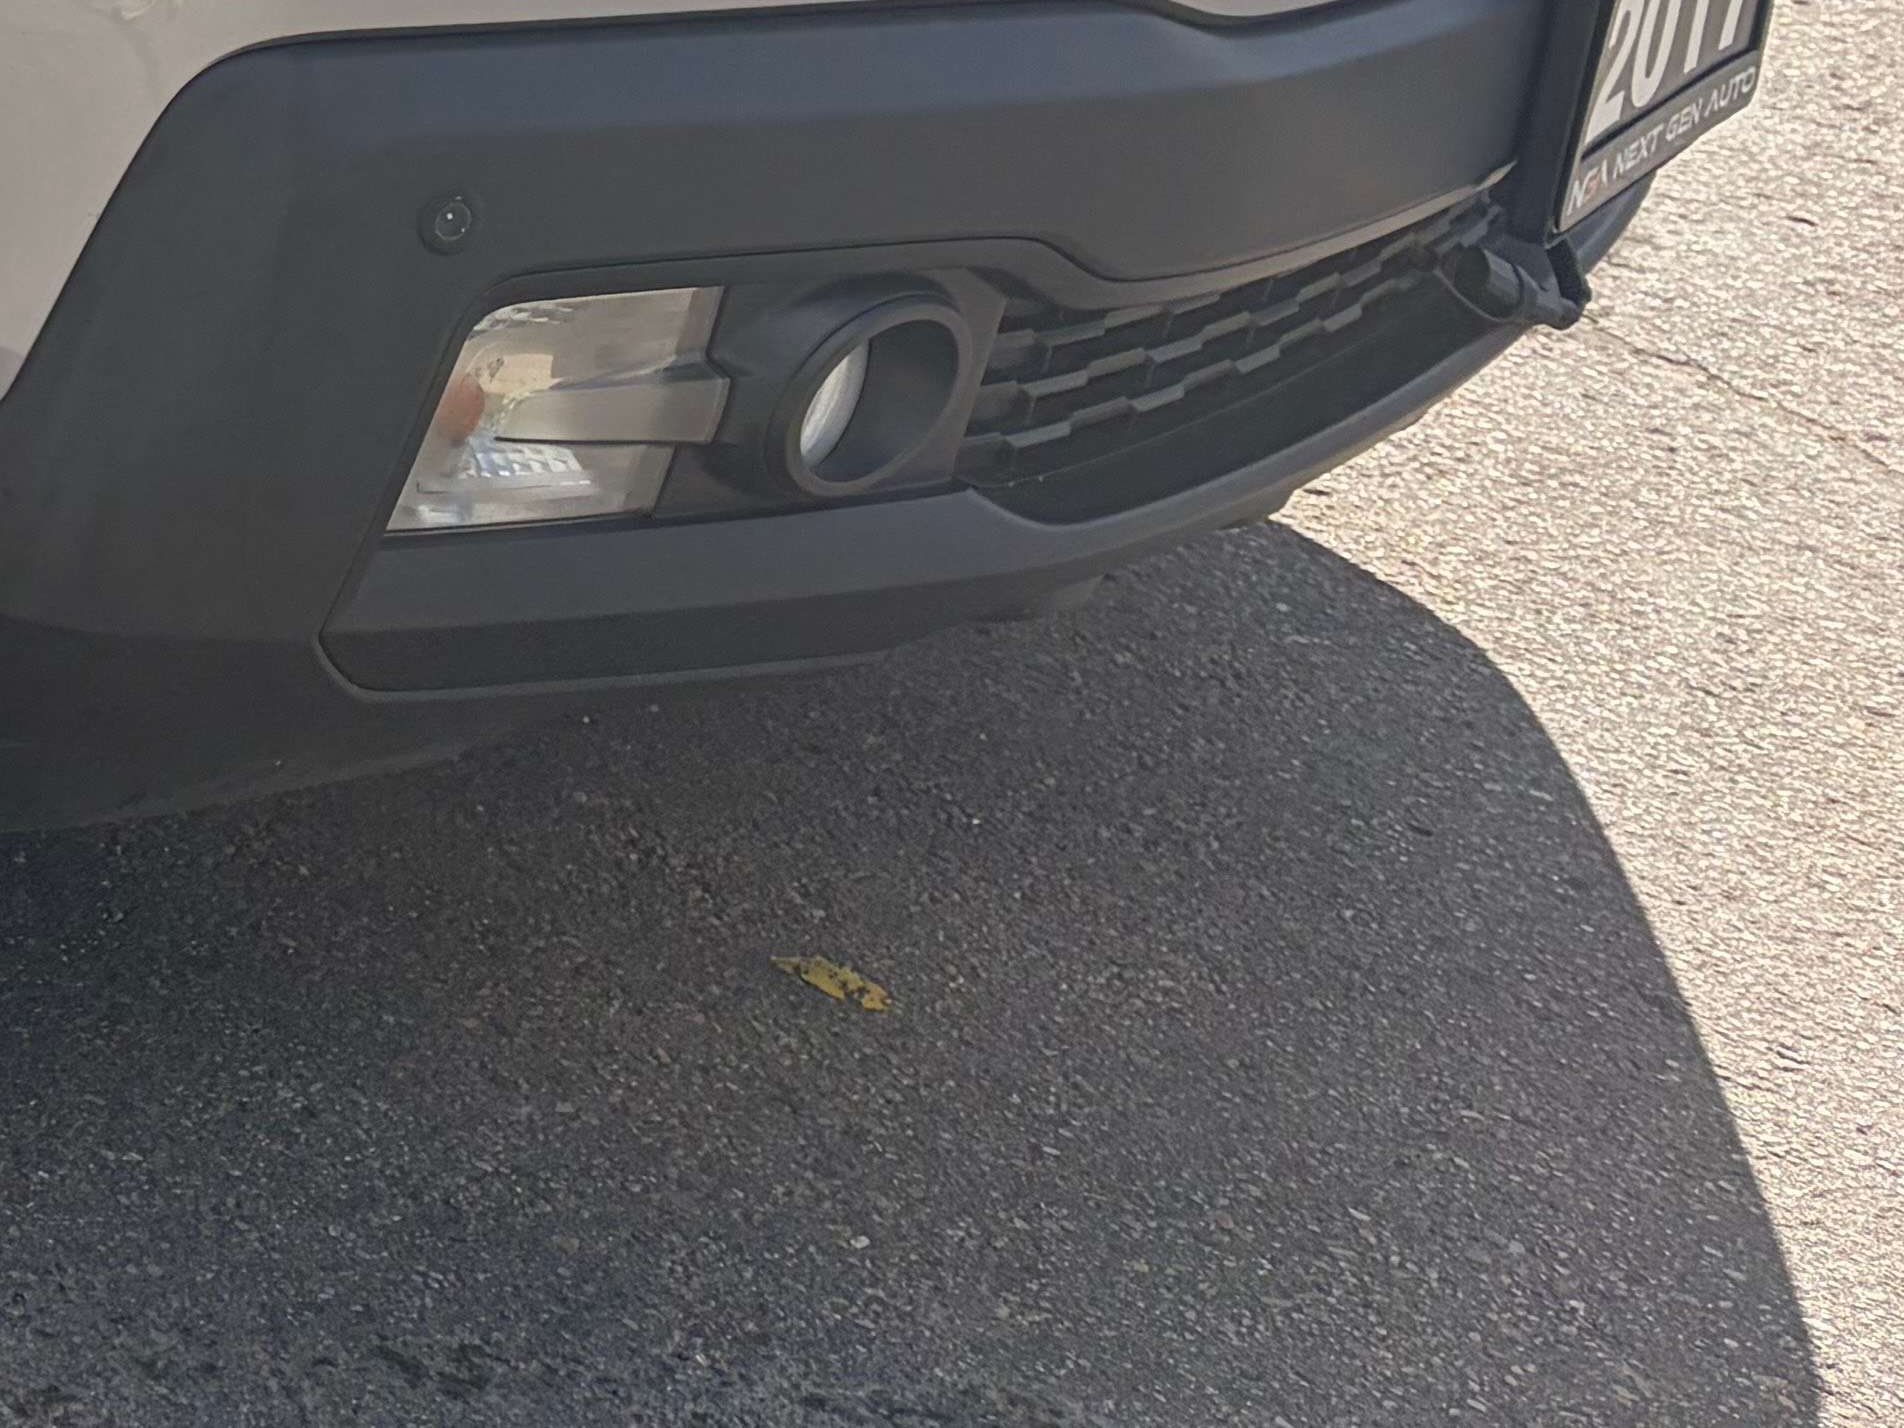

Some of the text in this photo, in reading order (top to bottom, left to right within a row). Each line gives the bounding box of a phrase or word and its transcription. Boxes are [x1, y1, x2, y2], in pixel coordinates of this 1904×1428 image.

[1613, 123, 1664, 180] NEXT
[1665, 98, 1703, 142] GEN
[1704, 66, 1756, 118] AUTO
